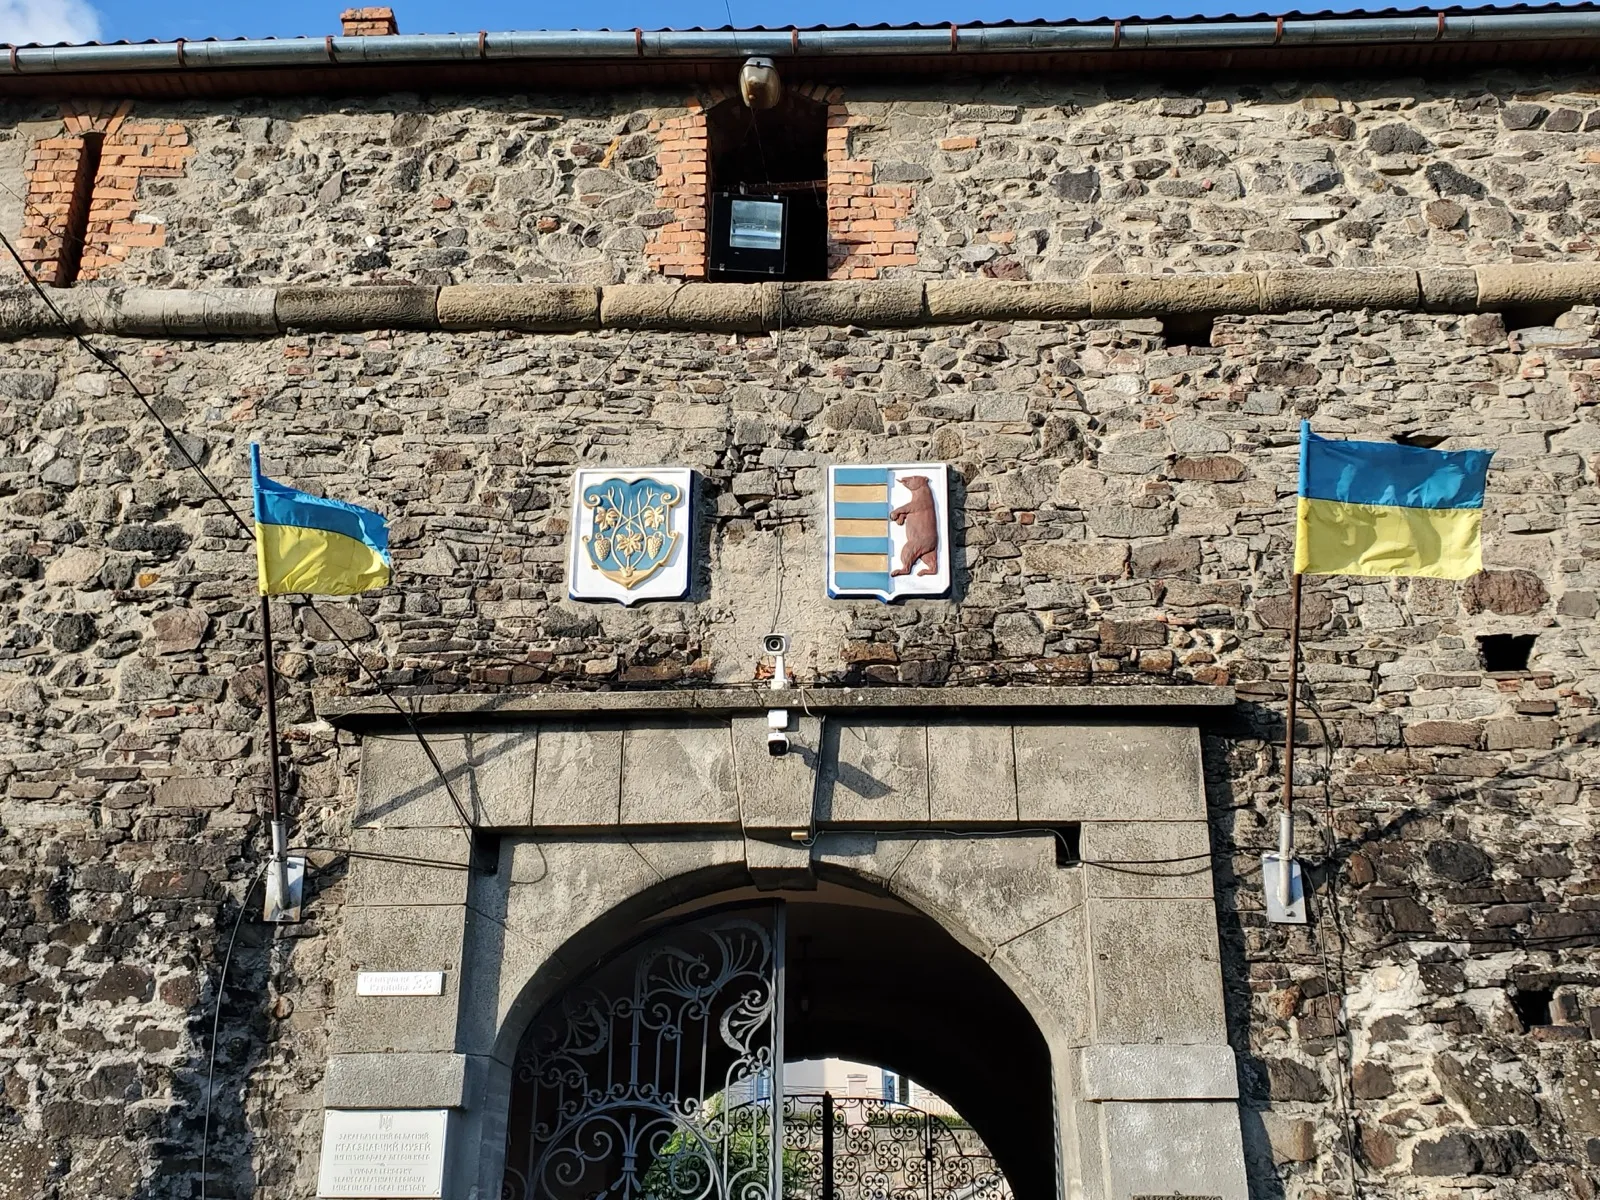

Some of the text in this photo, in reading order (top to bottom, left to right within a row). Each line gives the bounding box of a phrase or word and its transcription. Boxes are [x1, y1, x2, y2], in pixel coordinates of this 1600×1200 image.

[335, 1141, 432, 1152] КРАЄЗНАВЧИЙ МУЗЕЙ
[332, 1184, 426, 1192] MUSEUM OF LOCAL HISTORY
